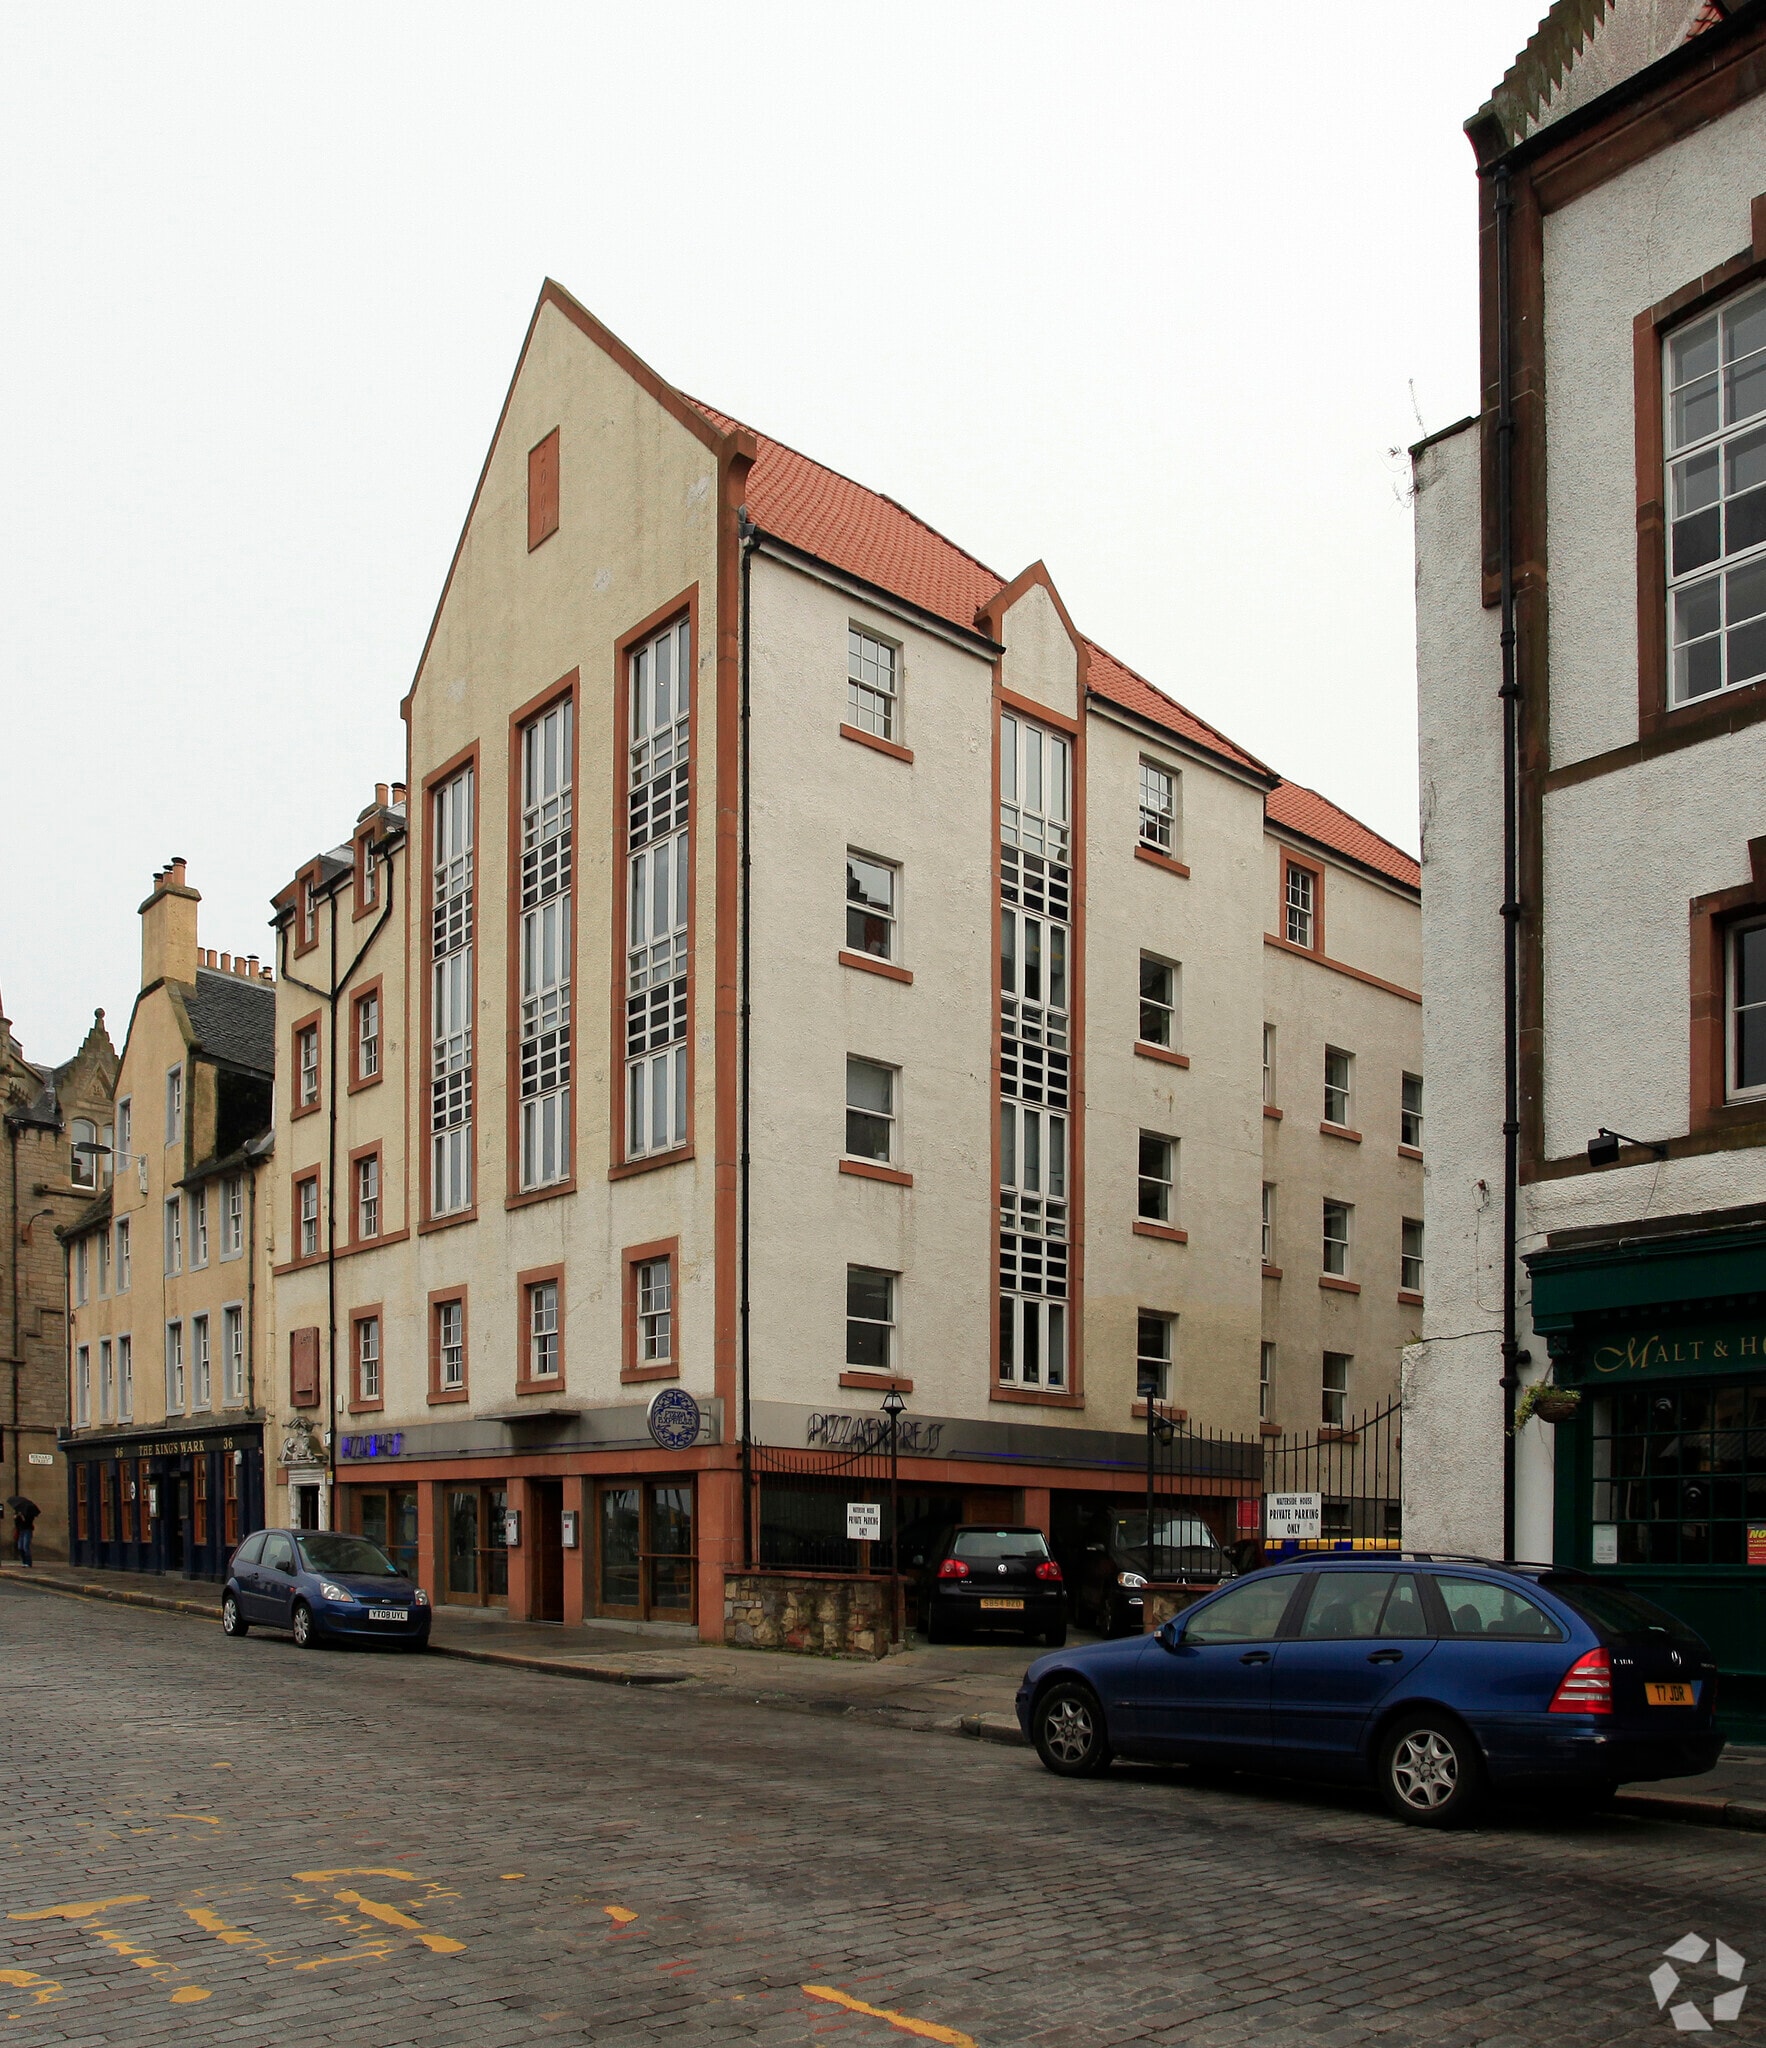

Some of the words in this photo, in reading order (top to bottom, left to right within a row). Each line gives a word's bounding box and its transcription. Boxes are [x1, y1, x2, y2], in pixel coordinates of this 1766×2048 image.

[1594, 1335, 1704, 1373] MALT
[1713, 1340, 1729, 1358] &
[1740, 1336, 1766, 1356] H
[664, 1410, 687, 1418] PIZZA
[658, 1417, 693, 1425] EXPRESS
[139, 1445, 153, 1456] THE
[155, 1442, 178, 1455] KING'S
[180, 1440, 205, 1452] WARK
[223, 1437, 234, 1450] 36
[114, 1447, 124, 1458] 36
[1276, 1497, 1297, 1505] WATERSIDE
[1300, 1497, 1313, 1505] HOUSE
[1269, 1509, 1291, 1520] PRIVATE
[1294, 1508, 1319, 1519] PARKING
[849, 1516, 862, 1524] PRIVATE
[863, 1516, 879, 1525] PARKING
[859, 1527, 868, 1536] ONLY
[1286, 1523, 1300, 1534] ONLY
[391, 1611, 405, 1619] UYL
[1654, 1685, 1667, 1702] T7
[1669, 1685, 1686, 1702] JDR
